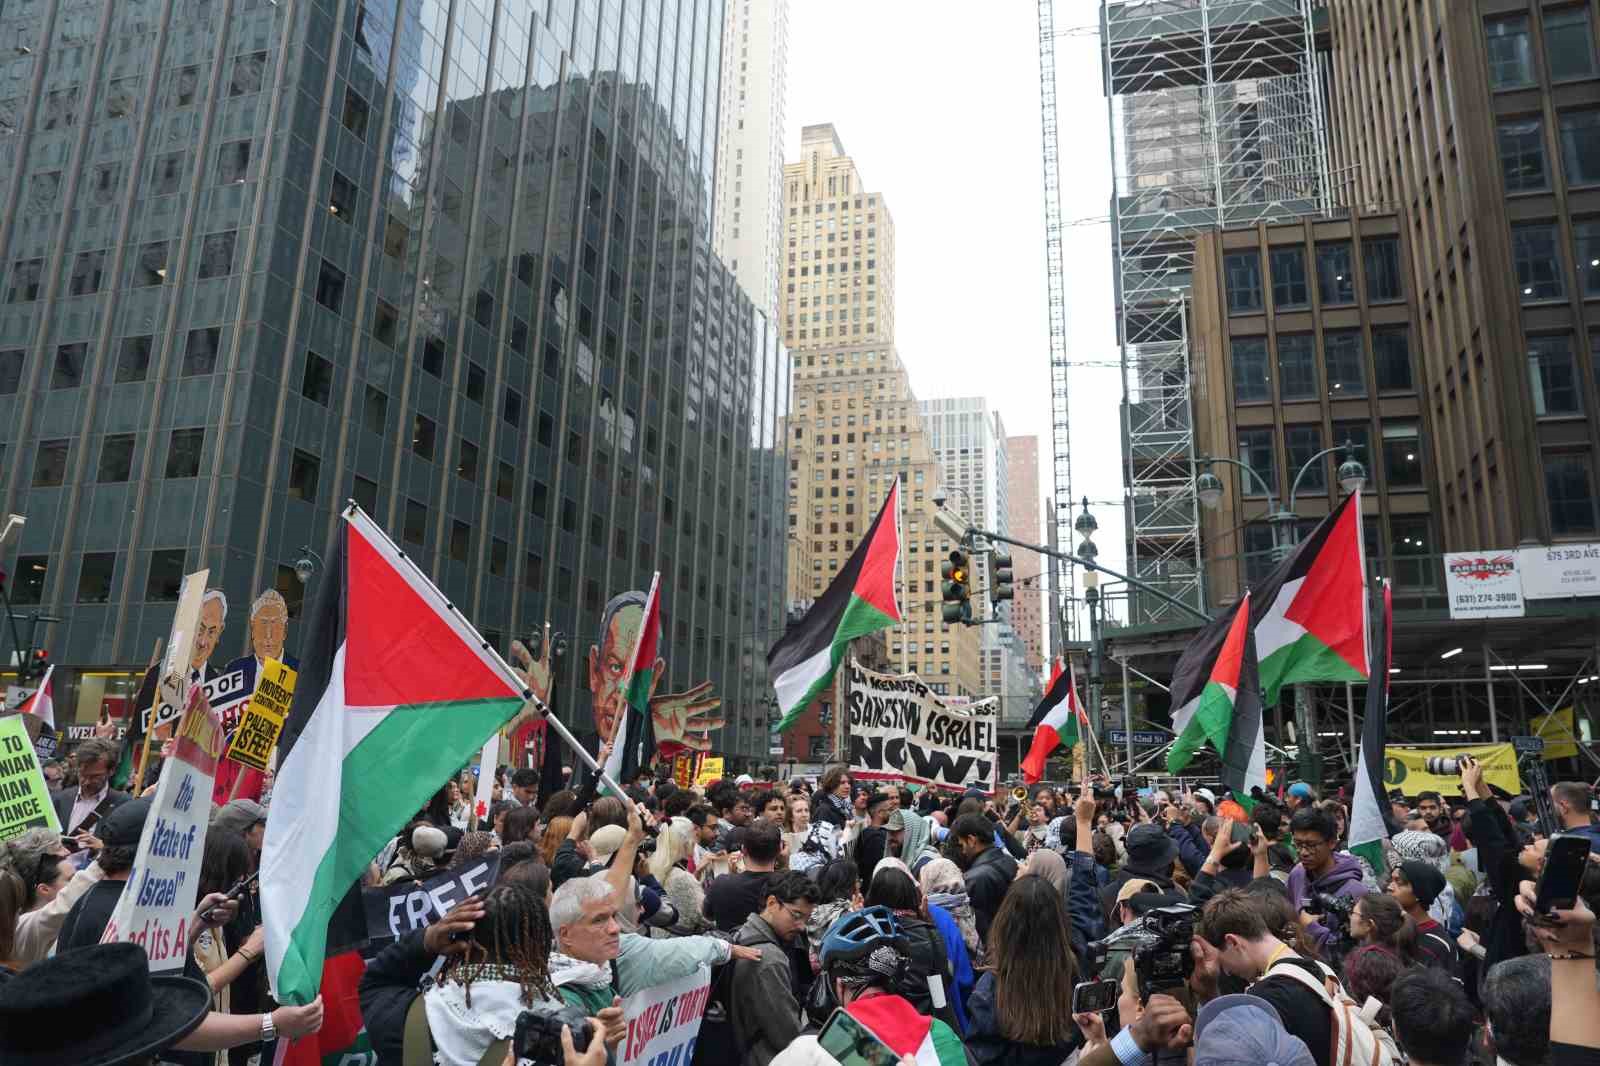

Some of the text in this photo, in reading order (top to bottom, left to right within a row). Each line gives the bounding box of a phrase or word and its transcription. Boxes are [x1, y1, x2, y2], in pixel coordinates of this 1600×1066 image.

[218, 672, 243, 693] OF
[2, 735, 23, 754] TO
[926, 711, 996, 753] ISRAEL
[850, 734, 993, 792] NOW!
[174, 774, 195, 813] the
[389, 862, 489, 942] FREE
[657, 995, 679, 1035] IS
